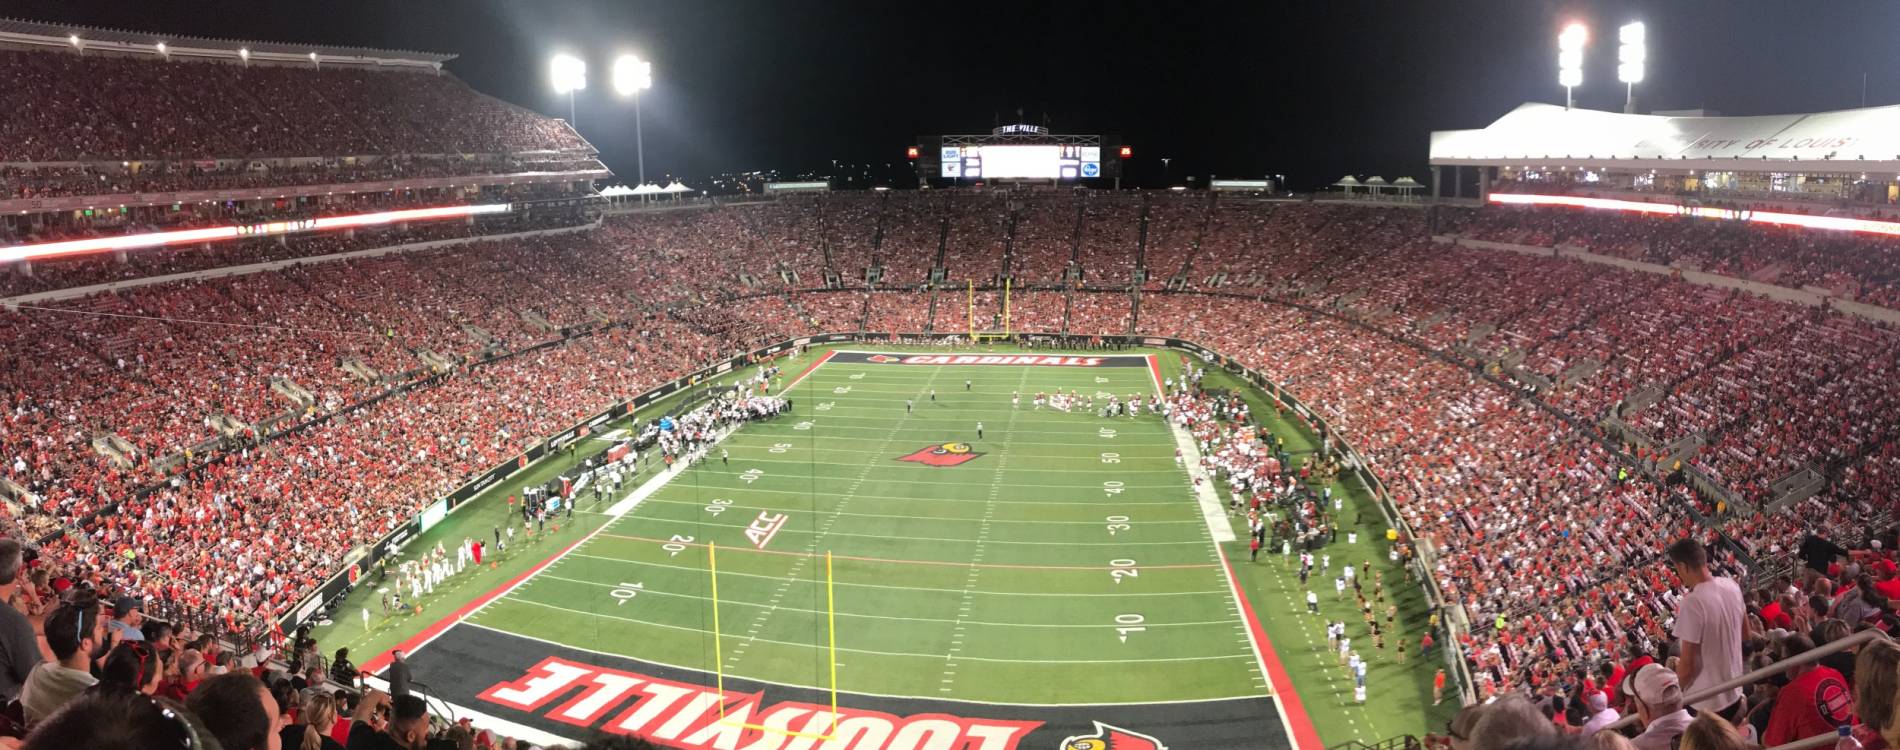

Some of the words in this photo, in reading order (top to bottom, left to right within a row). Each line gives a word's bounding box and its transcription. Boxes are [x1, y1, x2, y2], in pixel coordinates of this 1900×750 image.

[1002, 125, 1016, 133] THE
[1019, 124, 1039, 133] VILLE
[1745, 138, 1778, 149] OF
[903, 355, 1101, 367] CARDINALS
[768, 442, 792, 453] 50
[1102, 452, 1121, 464] 50
[739, 468, 764, 482] 40
[1104, 481, 1125, 494] 40
[704, 499, 733, 514] 30
[745, 510, 784, 546] ACC
[1106, 515, 1130, 531] 30
[662, 534, 695, 552] 20
[1110, 558, 1138, 577] 20
[610, 582, 643, 599] 10
[1115, 613, 1146, 634] 10
[482, 658, 1032, 750] LOUISVILLE
